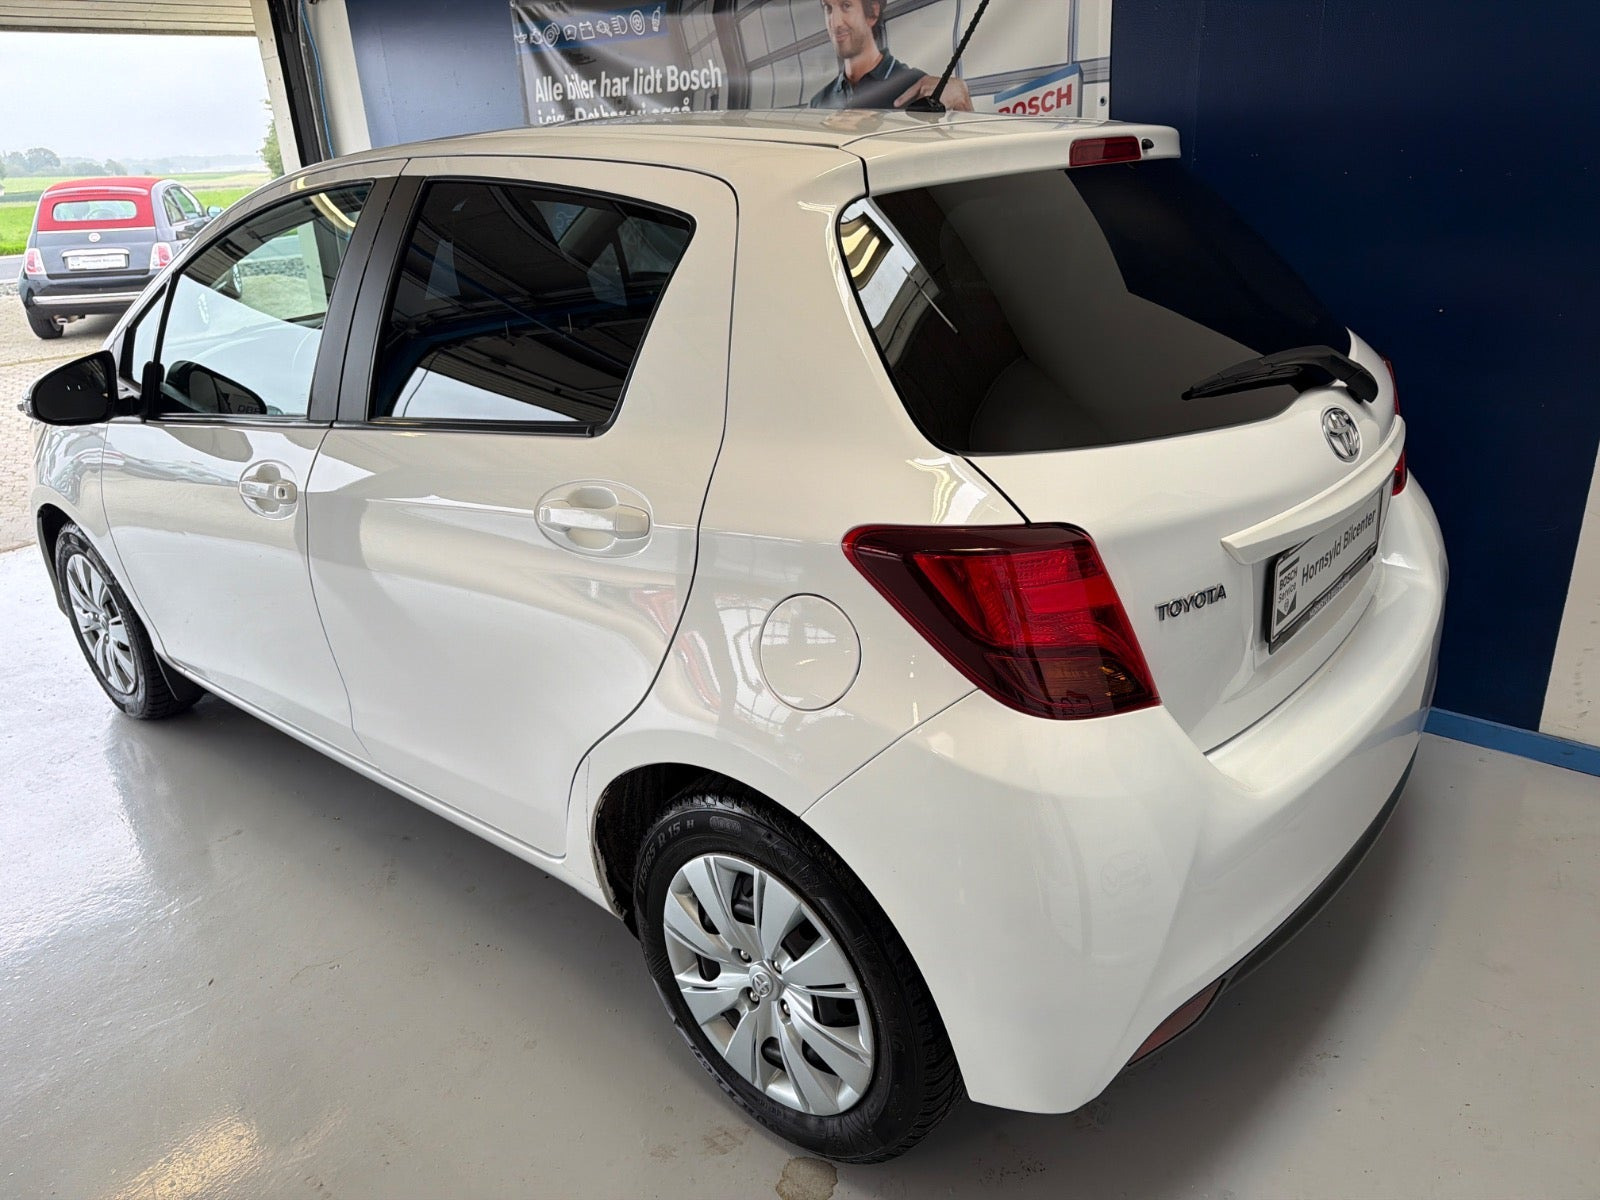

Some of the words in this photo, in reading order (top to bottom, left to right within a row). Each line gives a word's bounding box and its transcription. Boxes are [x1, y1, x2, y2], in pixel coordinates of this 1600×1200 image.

[535, 75, 563, 103] Alle
[564, 73, 597, 101] biler
[600, 71, 630, 98] har
[633, 66, 663, 96] lidt
[666, 60, 722, 93] Bosch
[1301, 535, 1342, 587] Hornsyld
[1343, 509, 1377, 550] Bilcenter
[1279, 566, 1298, 591] BOSCH
[1155, 583, 1226, 621] TOYOTA
[668, 821, 681, 839] 15
